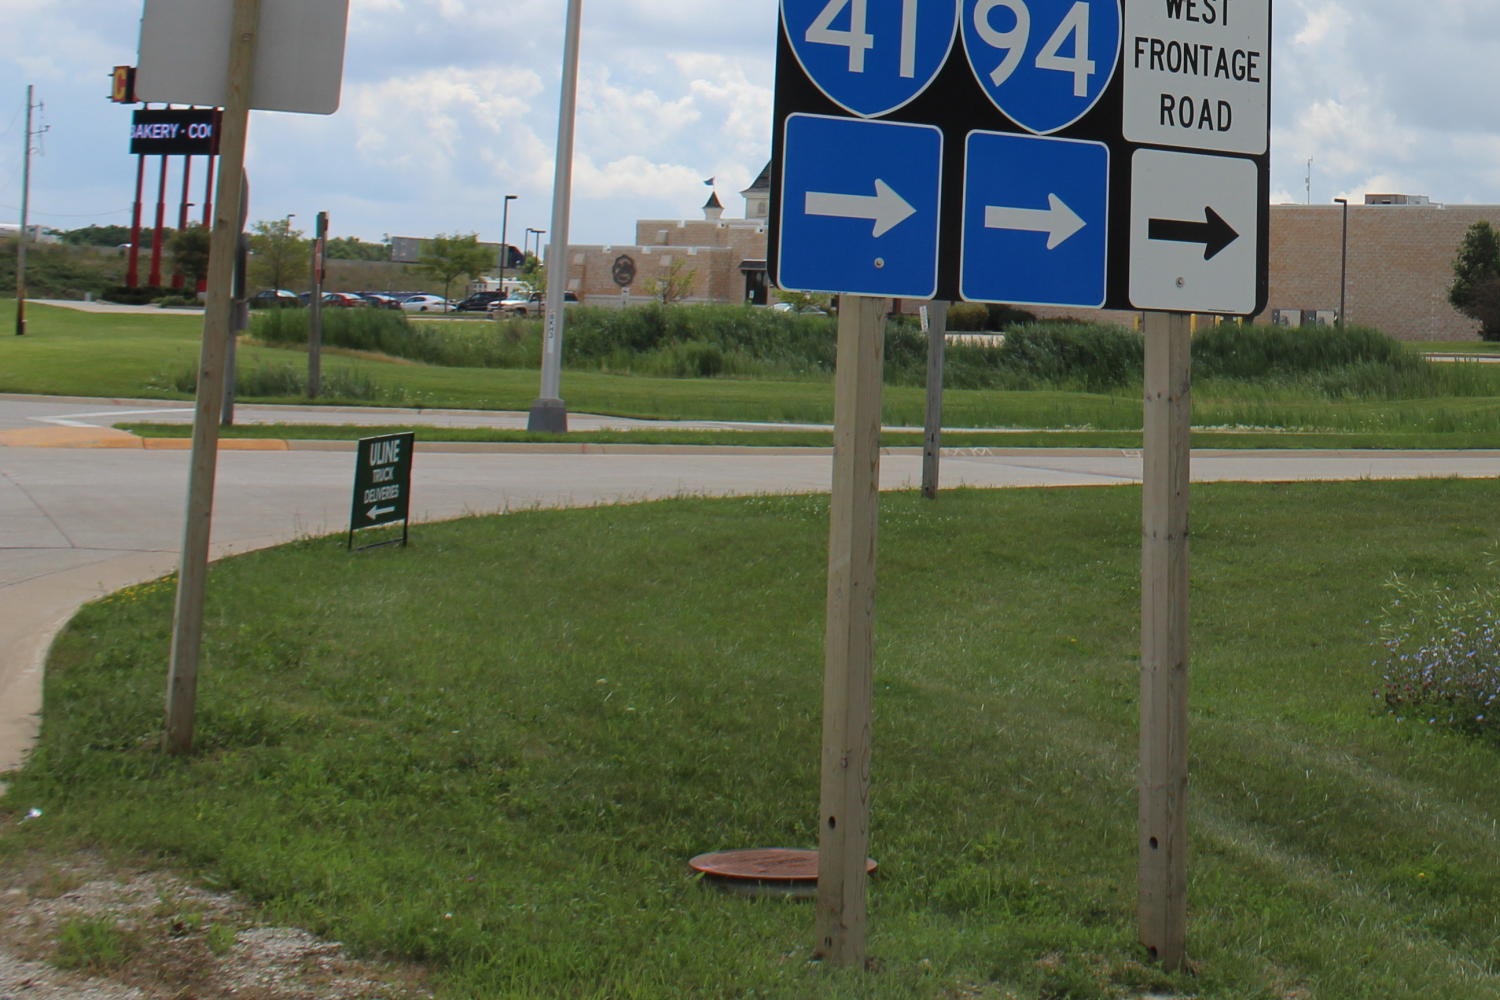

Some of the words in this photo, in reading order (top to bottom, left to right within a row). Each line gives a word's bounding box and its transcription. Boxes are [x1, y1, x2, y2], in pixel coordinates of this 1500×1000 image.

[1134, 36, 1260, 83] FRONTAGE
[1160, 93, 1232, 132] ROAD
[370, 440, 400, 466] ULINE
[373, 466, 394, 483] TRUCK
[364, 484, 400, 504] DELIVERIES
